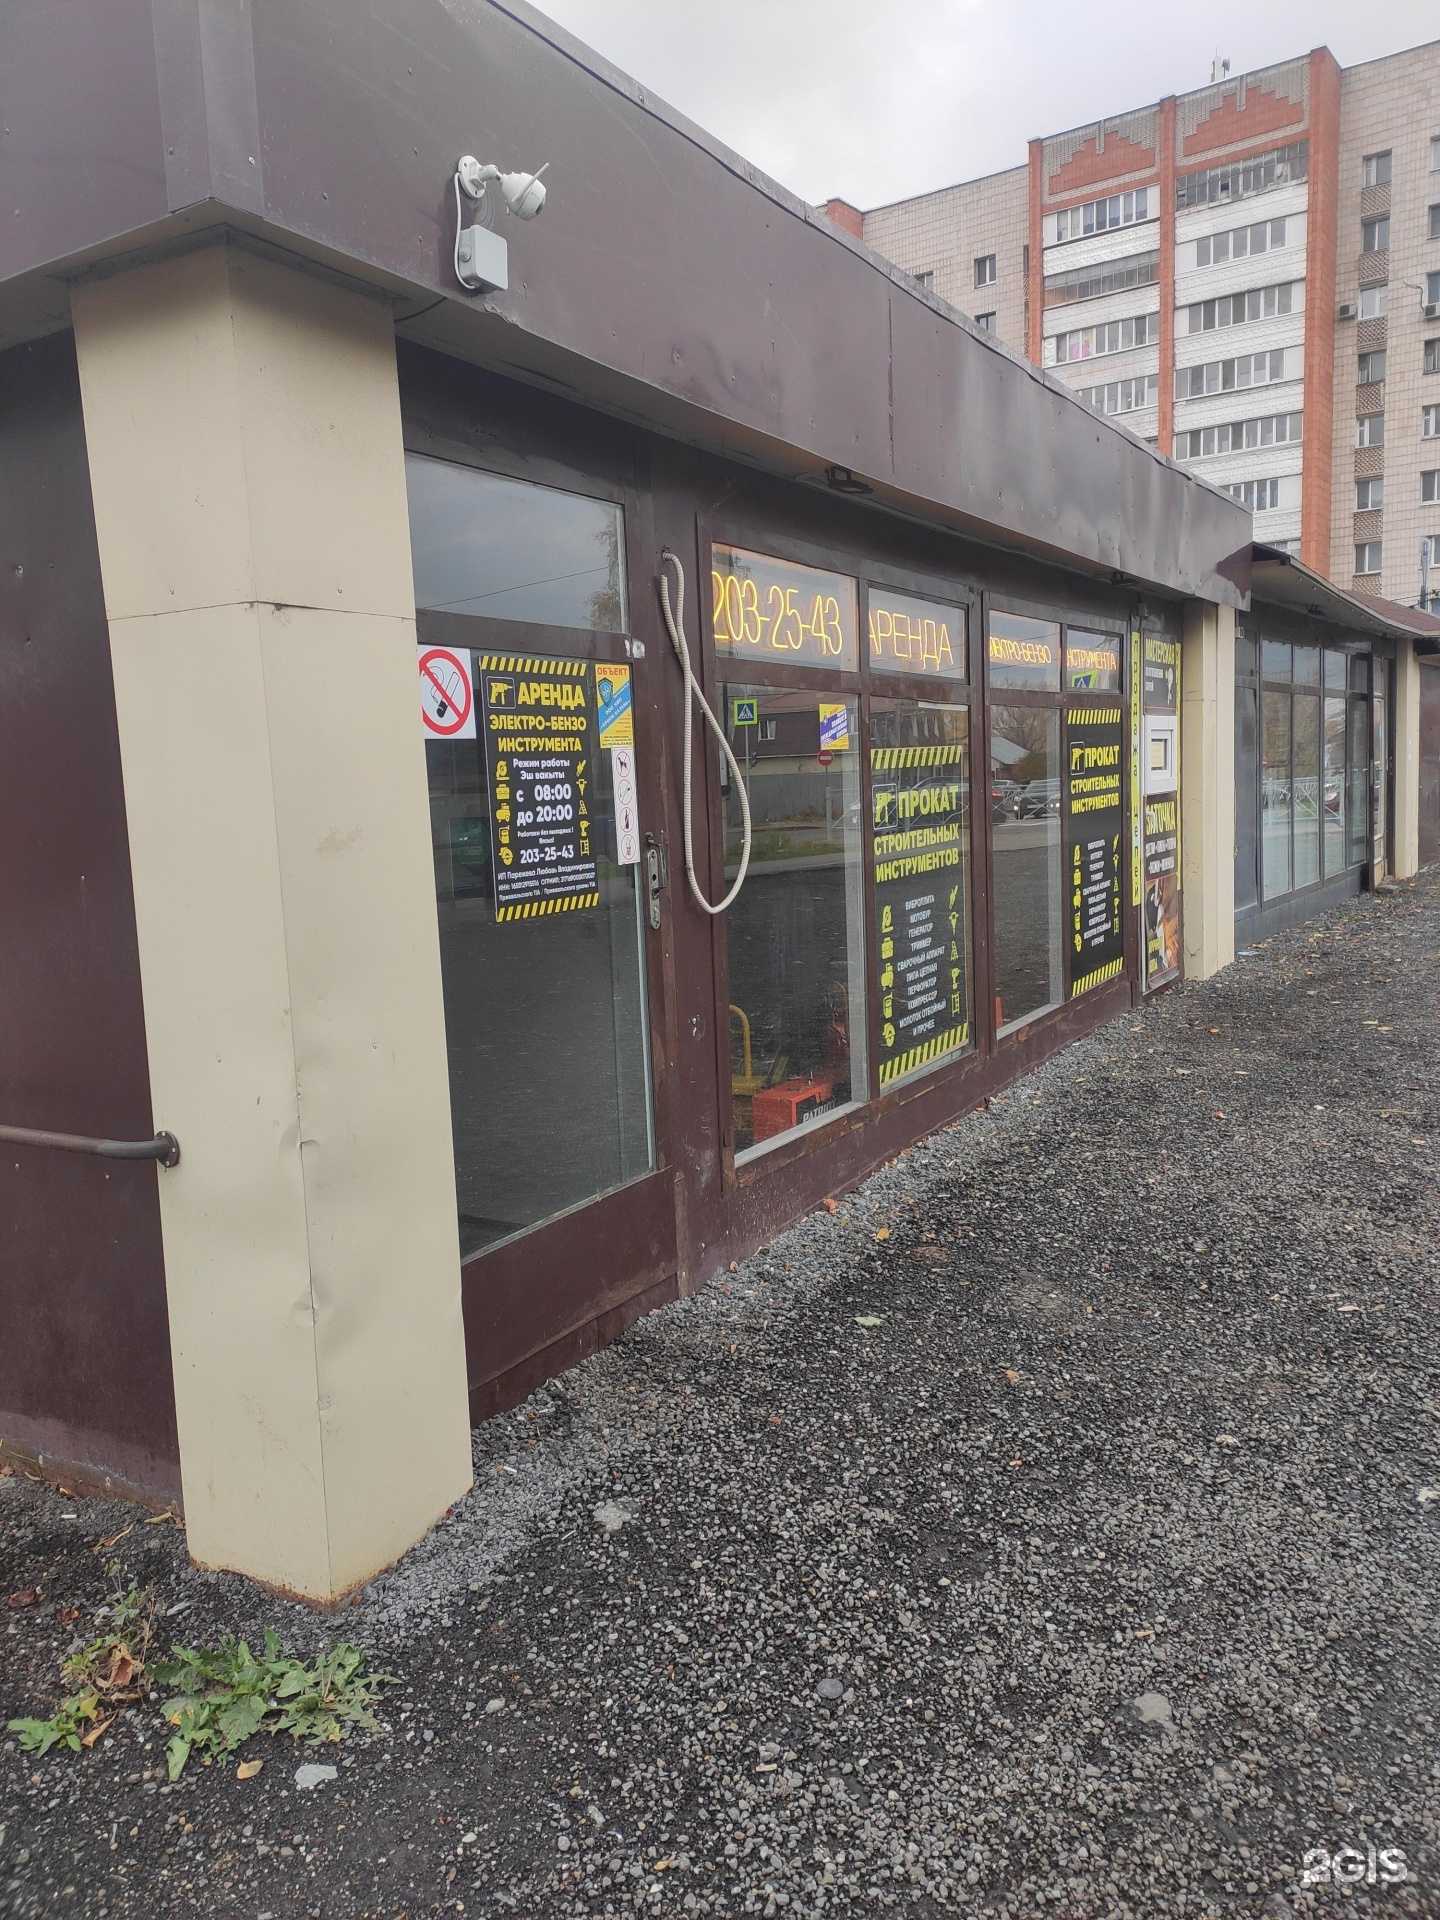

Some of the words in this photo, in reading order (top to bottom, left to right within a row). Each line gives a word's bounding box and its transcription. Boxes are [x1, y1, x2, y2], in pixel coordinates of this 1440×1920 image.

[712, 571, 843, 655] 203-25-43
[597, 667, 628, 677] ОБЪЕКТ
[518, 682, 586, 710] АРЕНДА
[489, 715, 586, 731] ЭЛЕКТРО-БЕНЗО
[498, 736, 582, 752] ИНСТРУМЕНТА
[513, 758, 540, 768] Режим
[541, 758, 570, 769] работы
[1085, 745, 1120, 768] ПРОКАТ
[520, 771, 534, 780] Эш
[535, 771, 565, 780] вакыты
[1071, 774, 1120, 795] СТРОИТЕЛЬНЫХ
[516, 790, 525, 802] с
[534, 784, 572, 801] 08:00
[898, 785, 959, 819] ПРОКАТ
[1072, 793, 1119, 815] ИНСТРУМЕНТОВ
[517, 811, 534, 827] до
[536, 804, 573, 823] 20:00
[873, 822, 960, 856] СТРОИТЕЛЬНЫХ
[520, 844, 574, 864] 203-25-43
[876, 848, 959, 883] ИНСТРУМЕНТОВ
